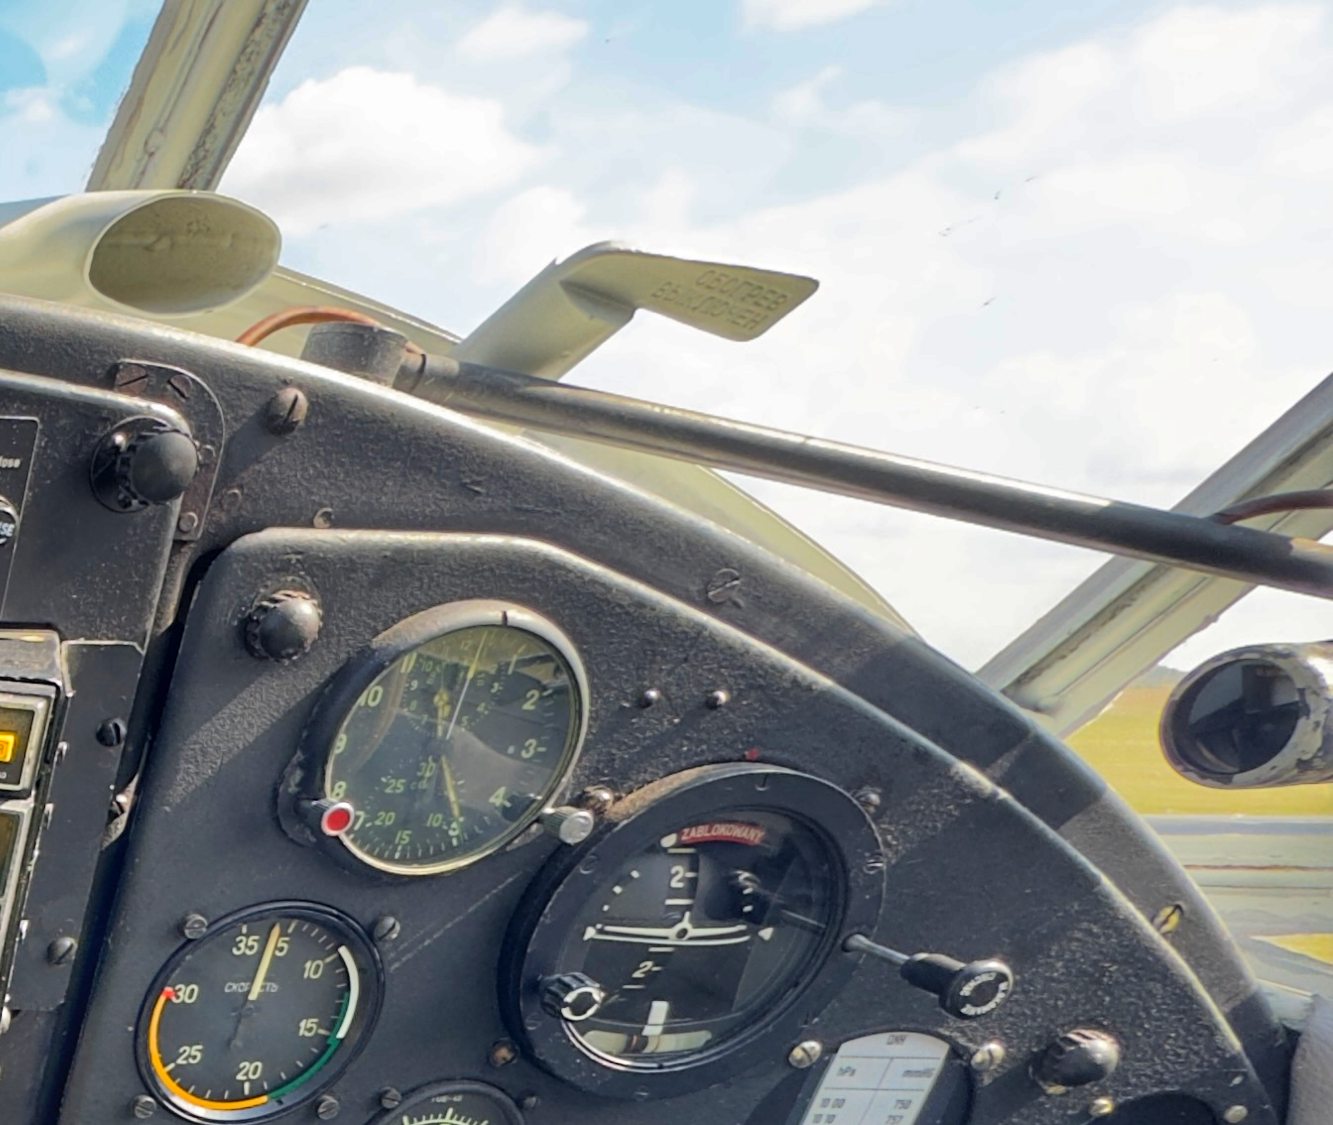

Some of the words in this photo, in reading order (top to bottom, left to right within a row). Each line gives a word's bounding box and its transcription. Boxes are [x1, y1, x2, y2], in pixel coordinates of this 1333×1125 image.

[681, 825, 764, 844] ZABLOKOWANY
[232, 936, 259, 955] 35
[303, 960, 323, 978] 10
[173, 984, 198, 1004] 30
[299, 1018, 318, 1036] 15
[177, 1046, 203, 1064] 25
[237, 1062, 262, 1080] 20
